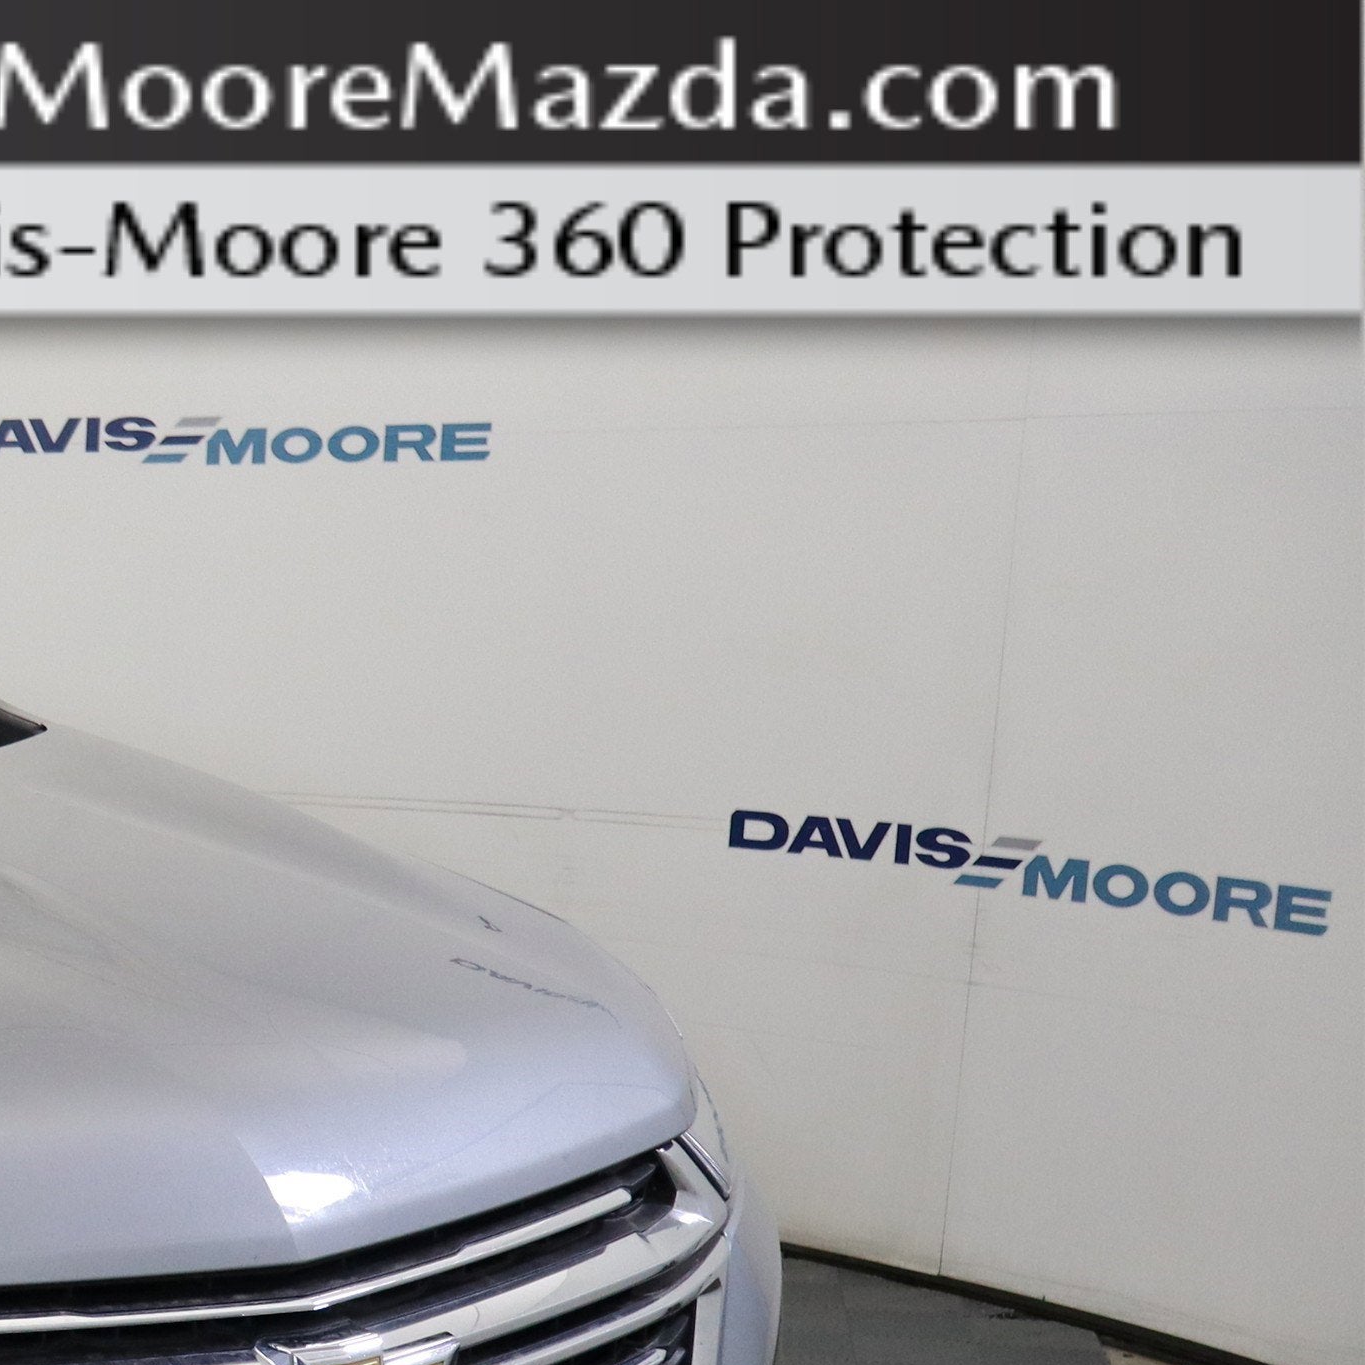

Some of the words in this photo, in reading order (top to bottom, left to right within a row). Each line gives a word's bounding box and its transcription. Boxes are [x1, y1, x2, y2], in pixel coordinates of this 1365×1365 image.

[206, 422, 492, 465] MOORE
[728, 809, 971, 870] DAVIS
[1021, 854, 1333, 937] MOORE
